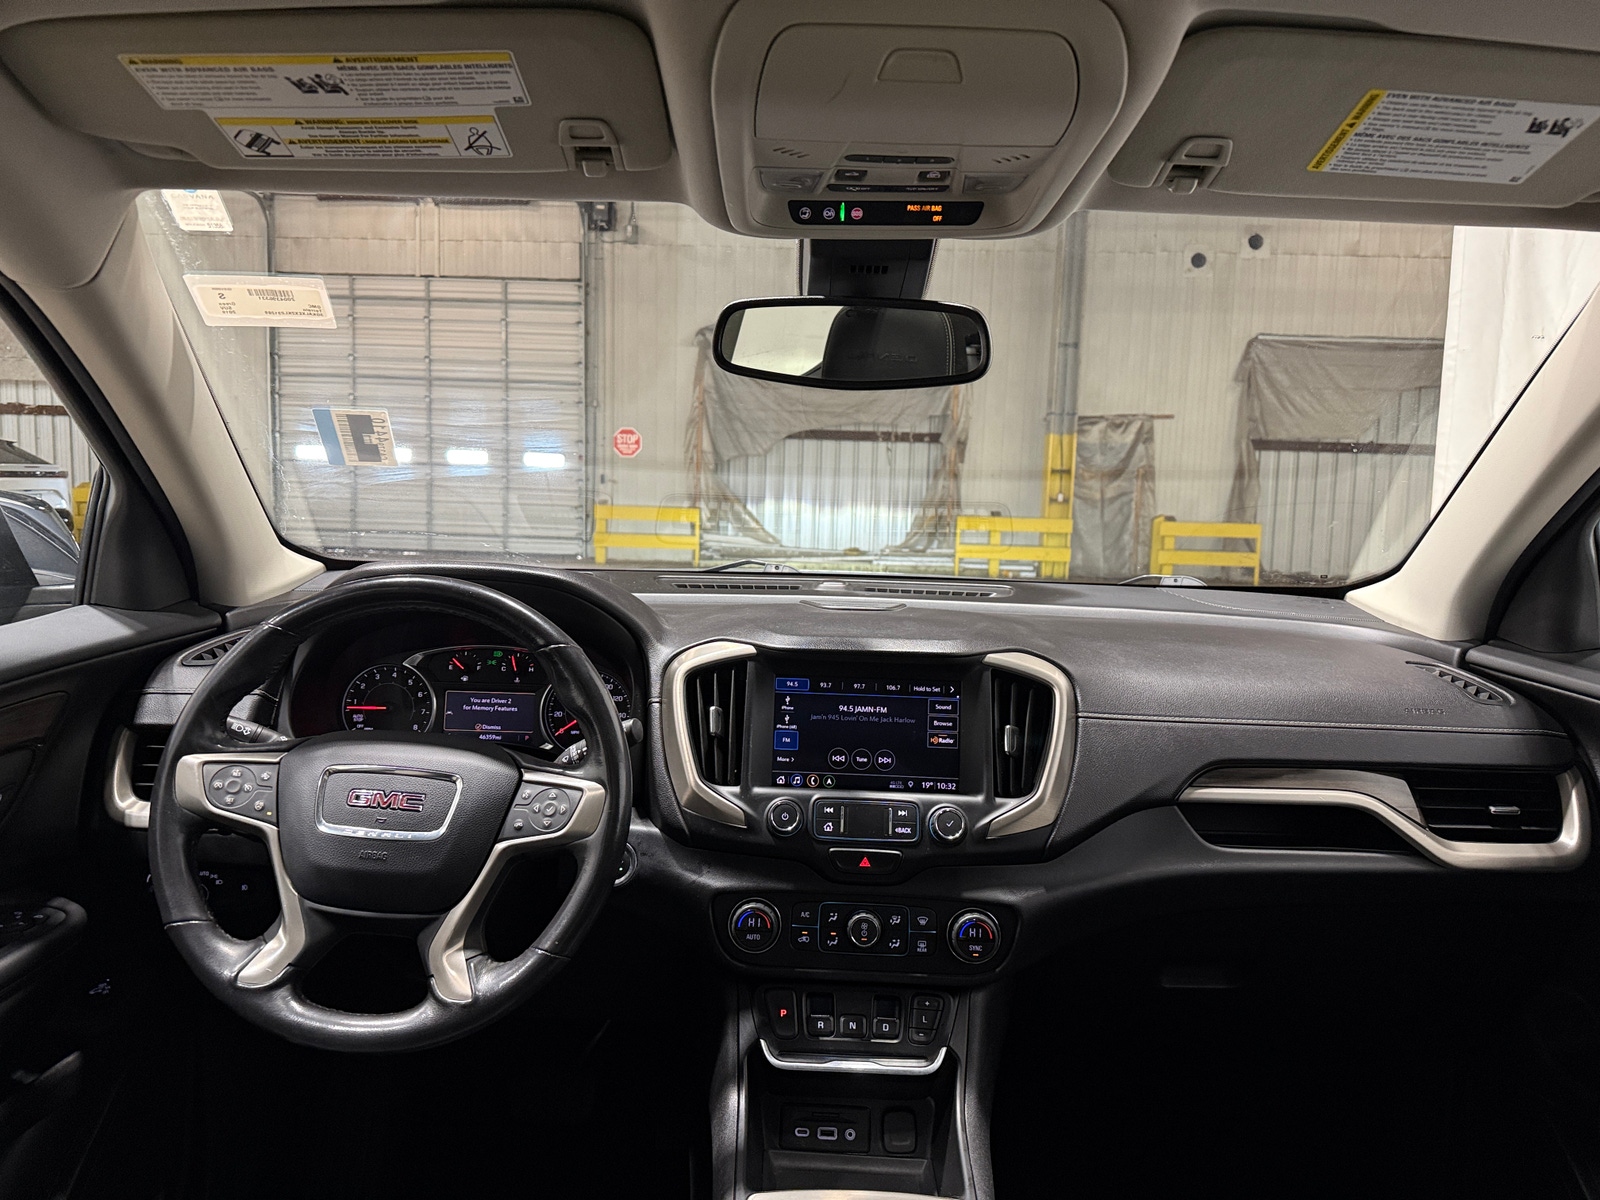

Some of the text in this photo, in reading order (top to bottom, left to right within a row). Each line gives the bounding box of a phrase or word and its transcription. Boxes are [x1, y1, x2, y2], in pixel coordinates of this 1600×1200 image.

[907, 204, 921, 212] PASS
[616, 433, 639, 444] STOP
[472, 705, 494, 713] Memory
[838, 704, 888, 714] 94.5 JAMN-FM
[880, 716, 893, 724] Jack
[922, 781, 934, 789] 19°
[936, 782, 956, 790] 10:32
[347, 789, 427, 812] GMC
[358, 850, 389, 860] AIRBAG
[780, 1009, 787, 1017] P
[817, 1021, 824, 1029] R
[849, 1021, 857, 1029] N
[882, 1023, 889, 1031] D
